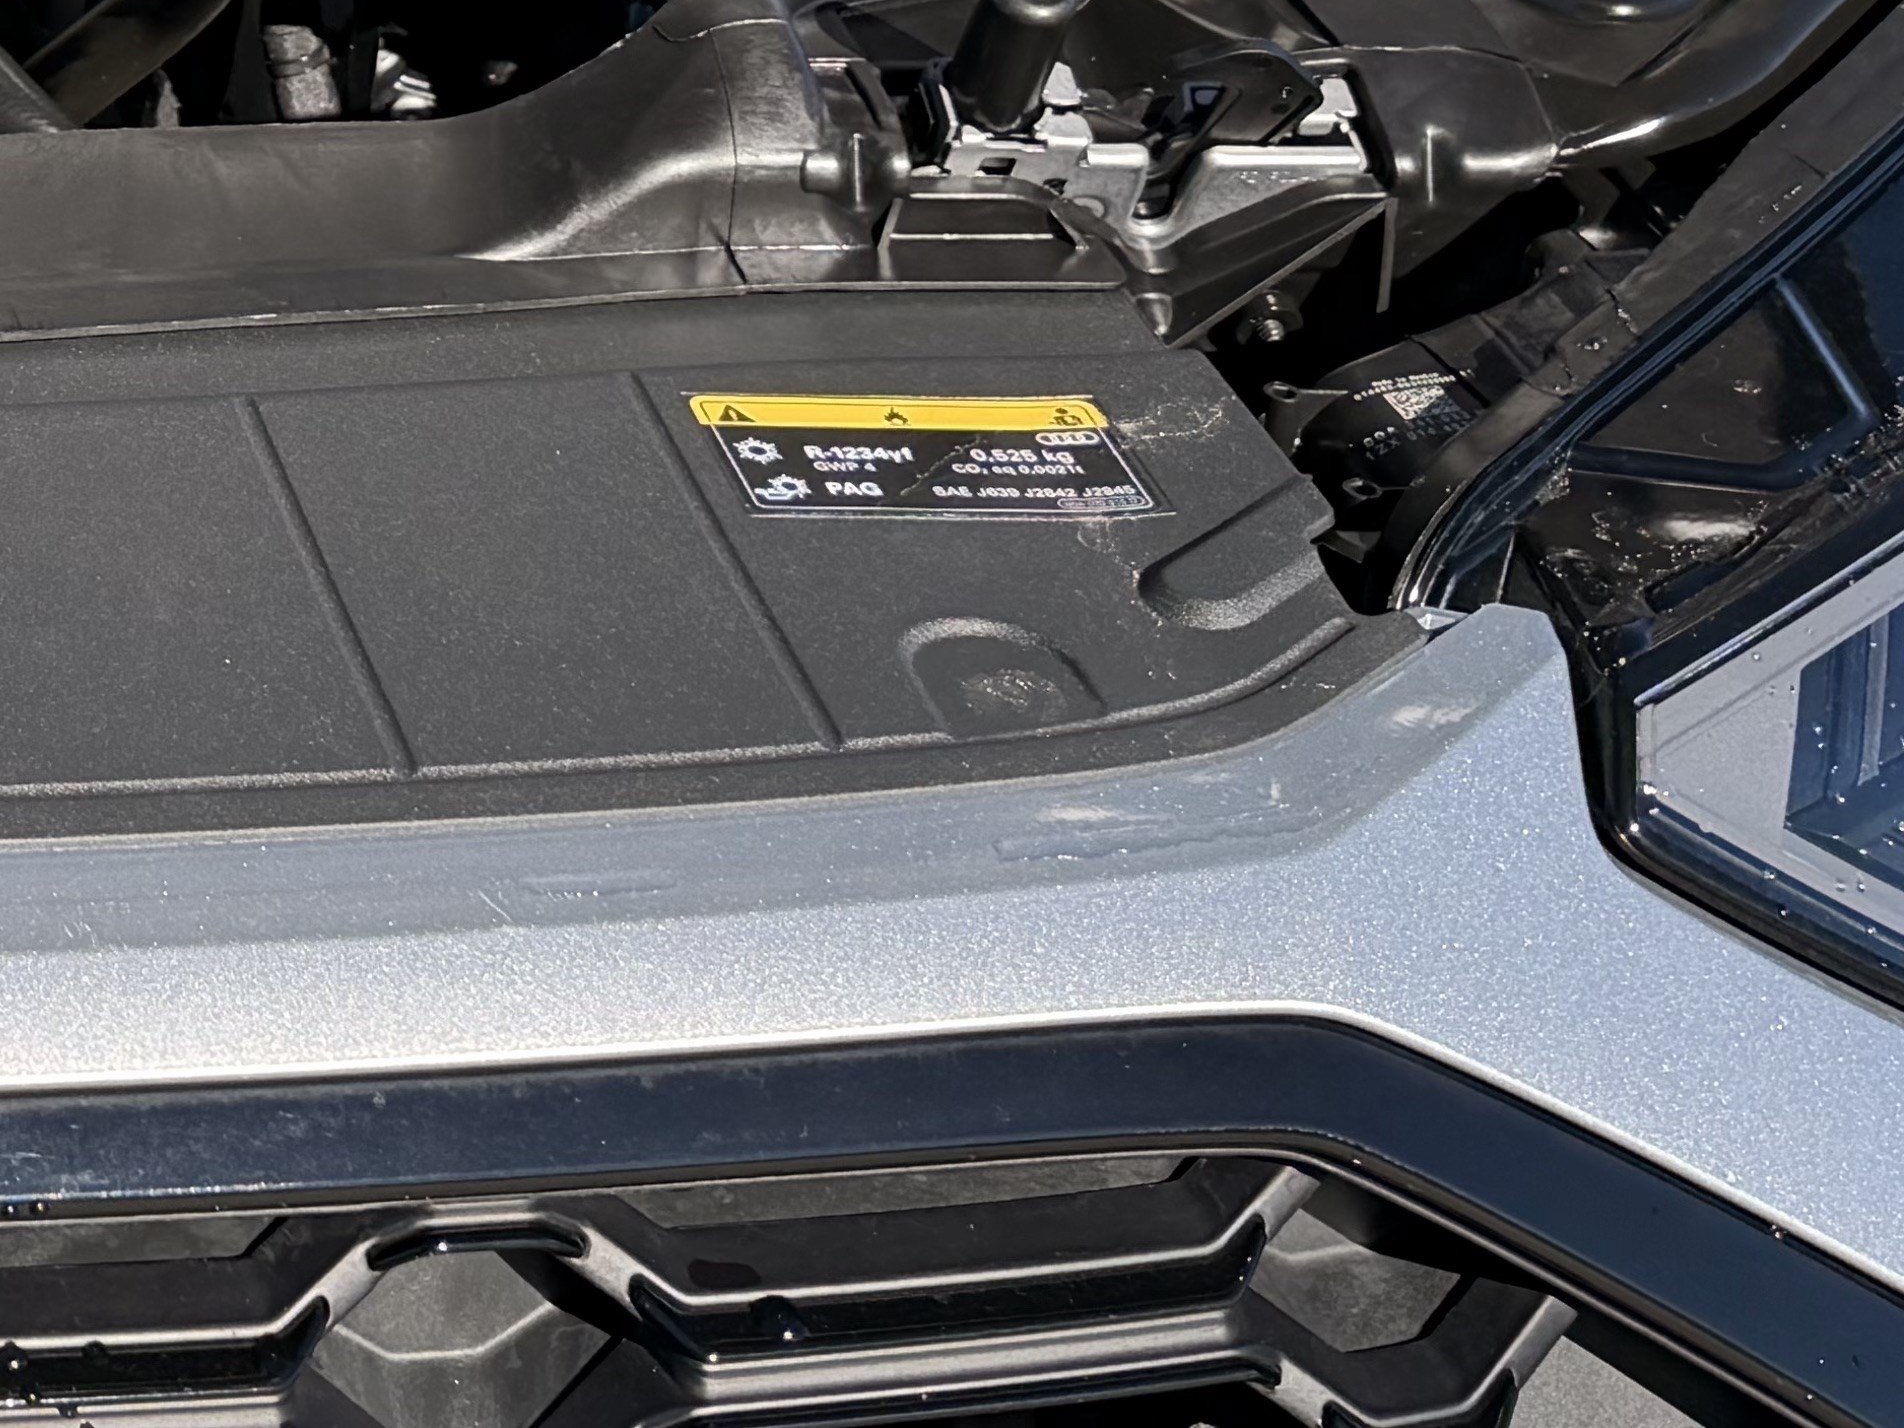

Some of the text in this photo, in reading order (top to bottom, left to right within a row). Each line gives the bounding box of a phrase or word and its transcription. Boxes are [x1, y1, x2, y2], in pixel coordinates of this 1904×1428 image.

[803, 445, 914, 464] R-1234yf
[1041, 449, 1075, 465] kg
[813, 461, 861, 473] GWP
[824, 481, 884, 497] PAG
[931, 485, 973, 498] SAE
[977, 486, 1020, 498] J639
[1024, 486, 1076, 498] J2842
